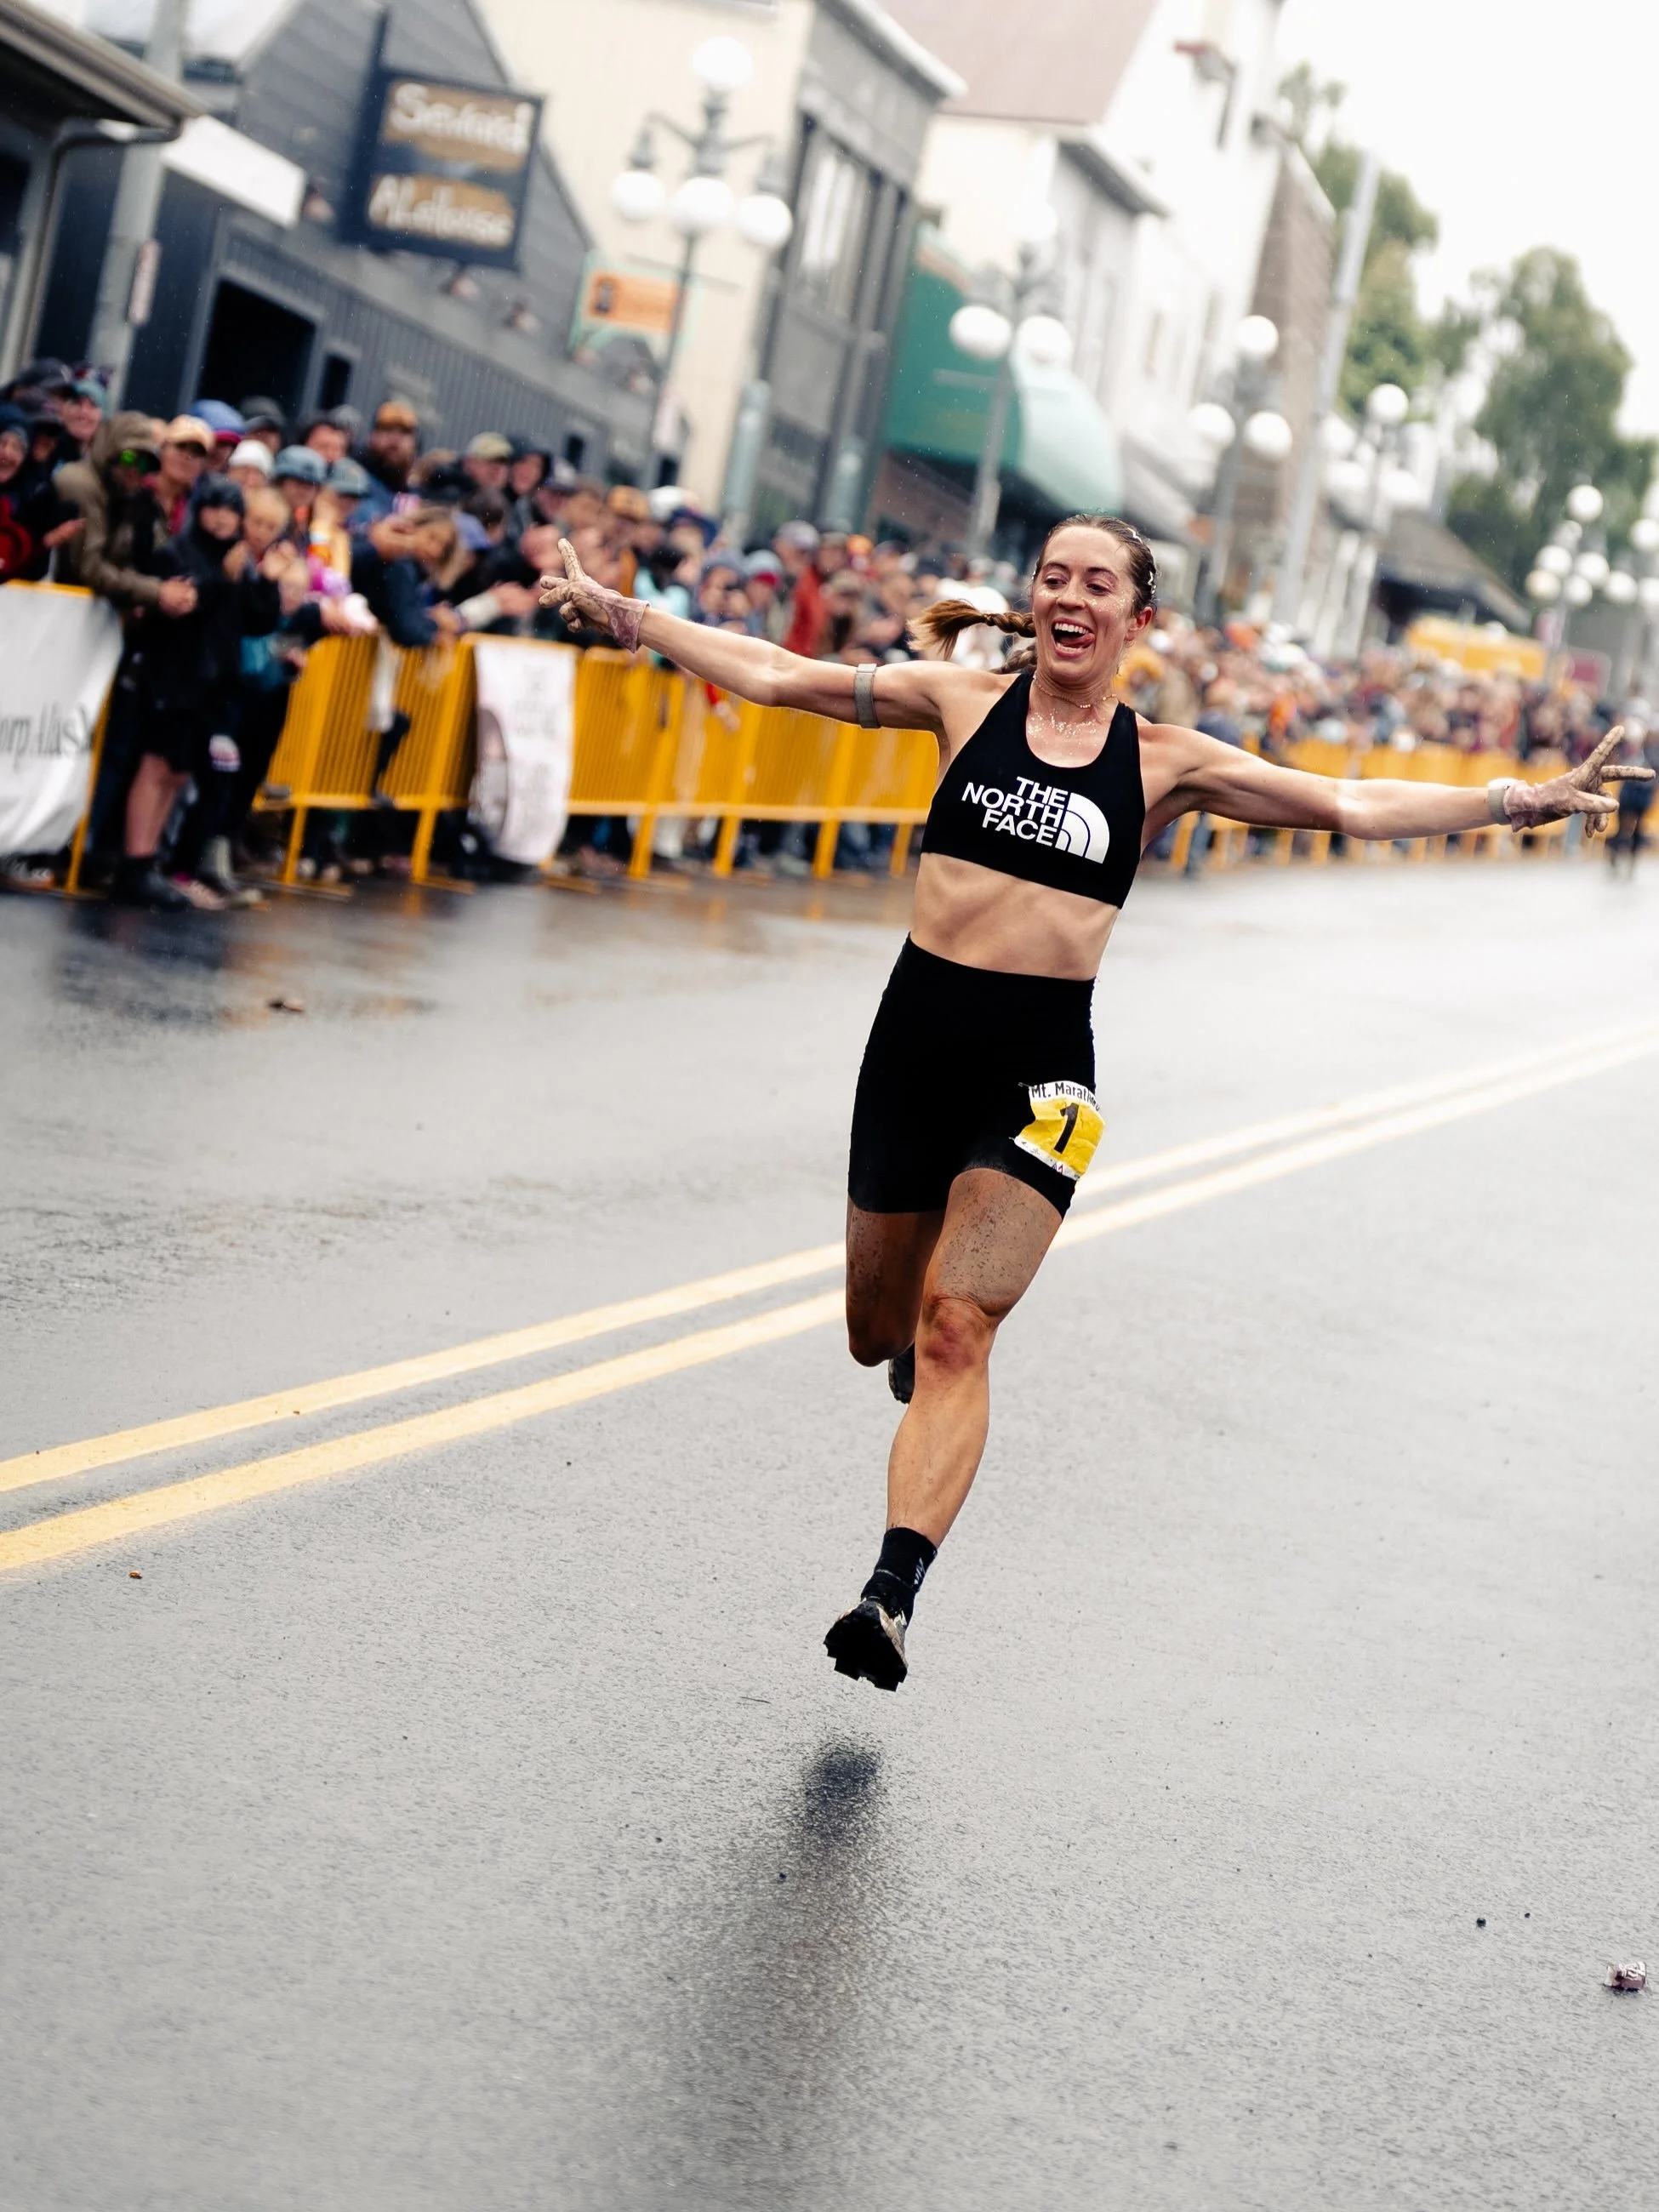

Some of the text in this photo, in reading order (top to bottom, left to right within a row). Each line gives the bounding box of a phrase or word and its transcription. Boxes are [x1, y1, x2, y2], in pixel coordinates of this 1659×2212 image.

[961, 782, 1064, 828] NORTH
[1016, 776, 1069, 809] THE
[982, 808, 1058, 847] FACE
[1031, 1083, 1052, 1098] Mt.
[1053, 1102, 1080, 1154] 1
